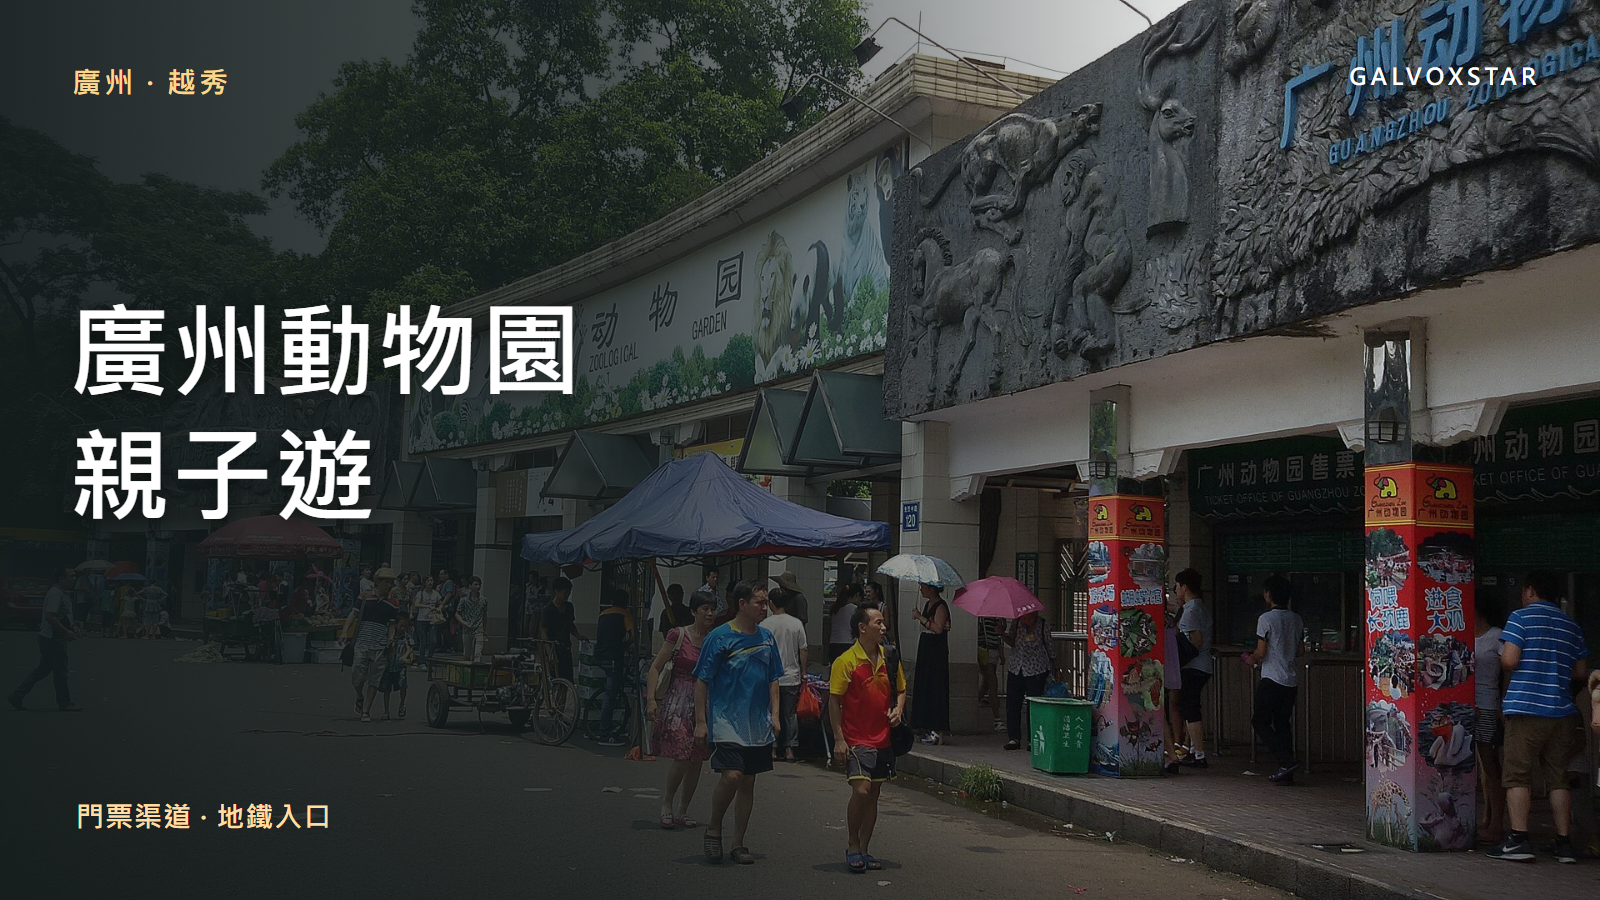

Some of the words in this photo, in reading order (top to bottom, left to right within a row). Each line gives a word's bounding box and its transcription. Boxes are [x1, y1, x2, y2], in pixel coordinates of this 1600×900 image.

[1329, 98, 1451, 166] GUANGZHOU
[588, 342, 639, 373] ZOOLOGICAL
[692, 311, 727, 341] GARDEN
[1196, 450, 1355, 490] 广州动物园售票
[1500, 467, 1546, 485] OFFICE
[1550, 465, 1569, 480] OF
[1204, 494, 1234, 506] TICKET
[1237, 491, 1268, 504] OFFICE
[1272, 490, 1284, 502] OF
[1287, 486, 1349, 501] GUANGZHOU
[905, 514, 916, 528] 120
[1425, 587, 1462, 612] 进食
[1367, 606, 1411, 633] 长颈鹿
[1427, 609, 1465, 633] 大观
